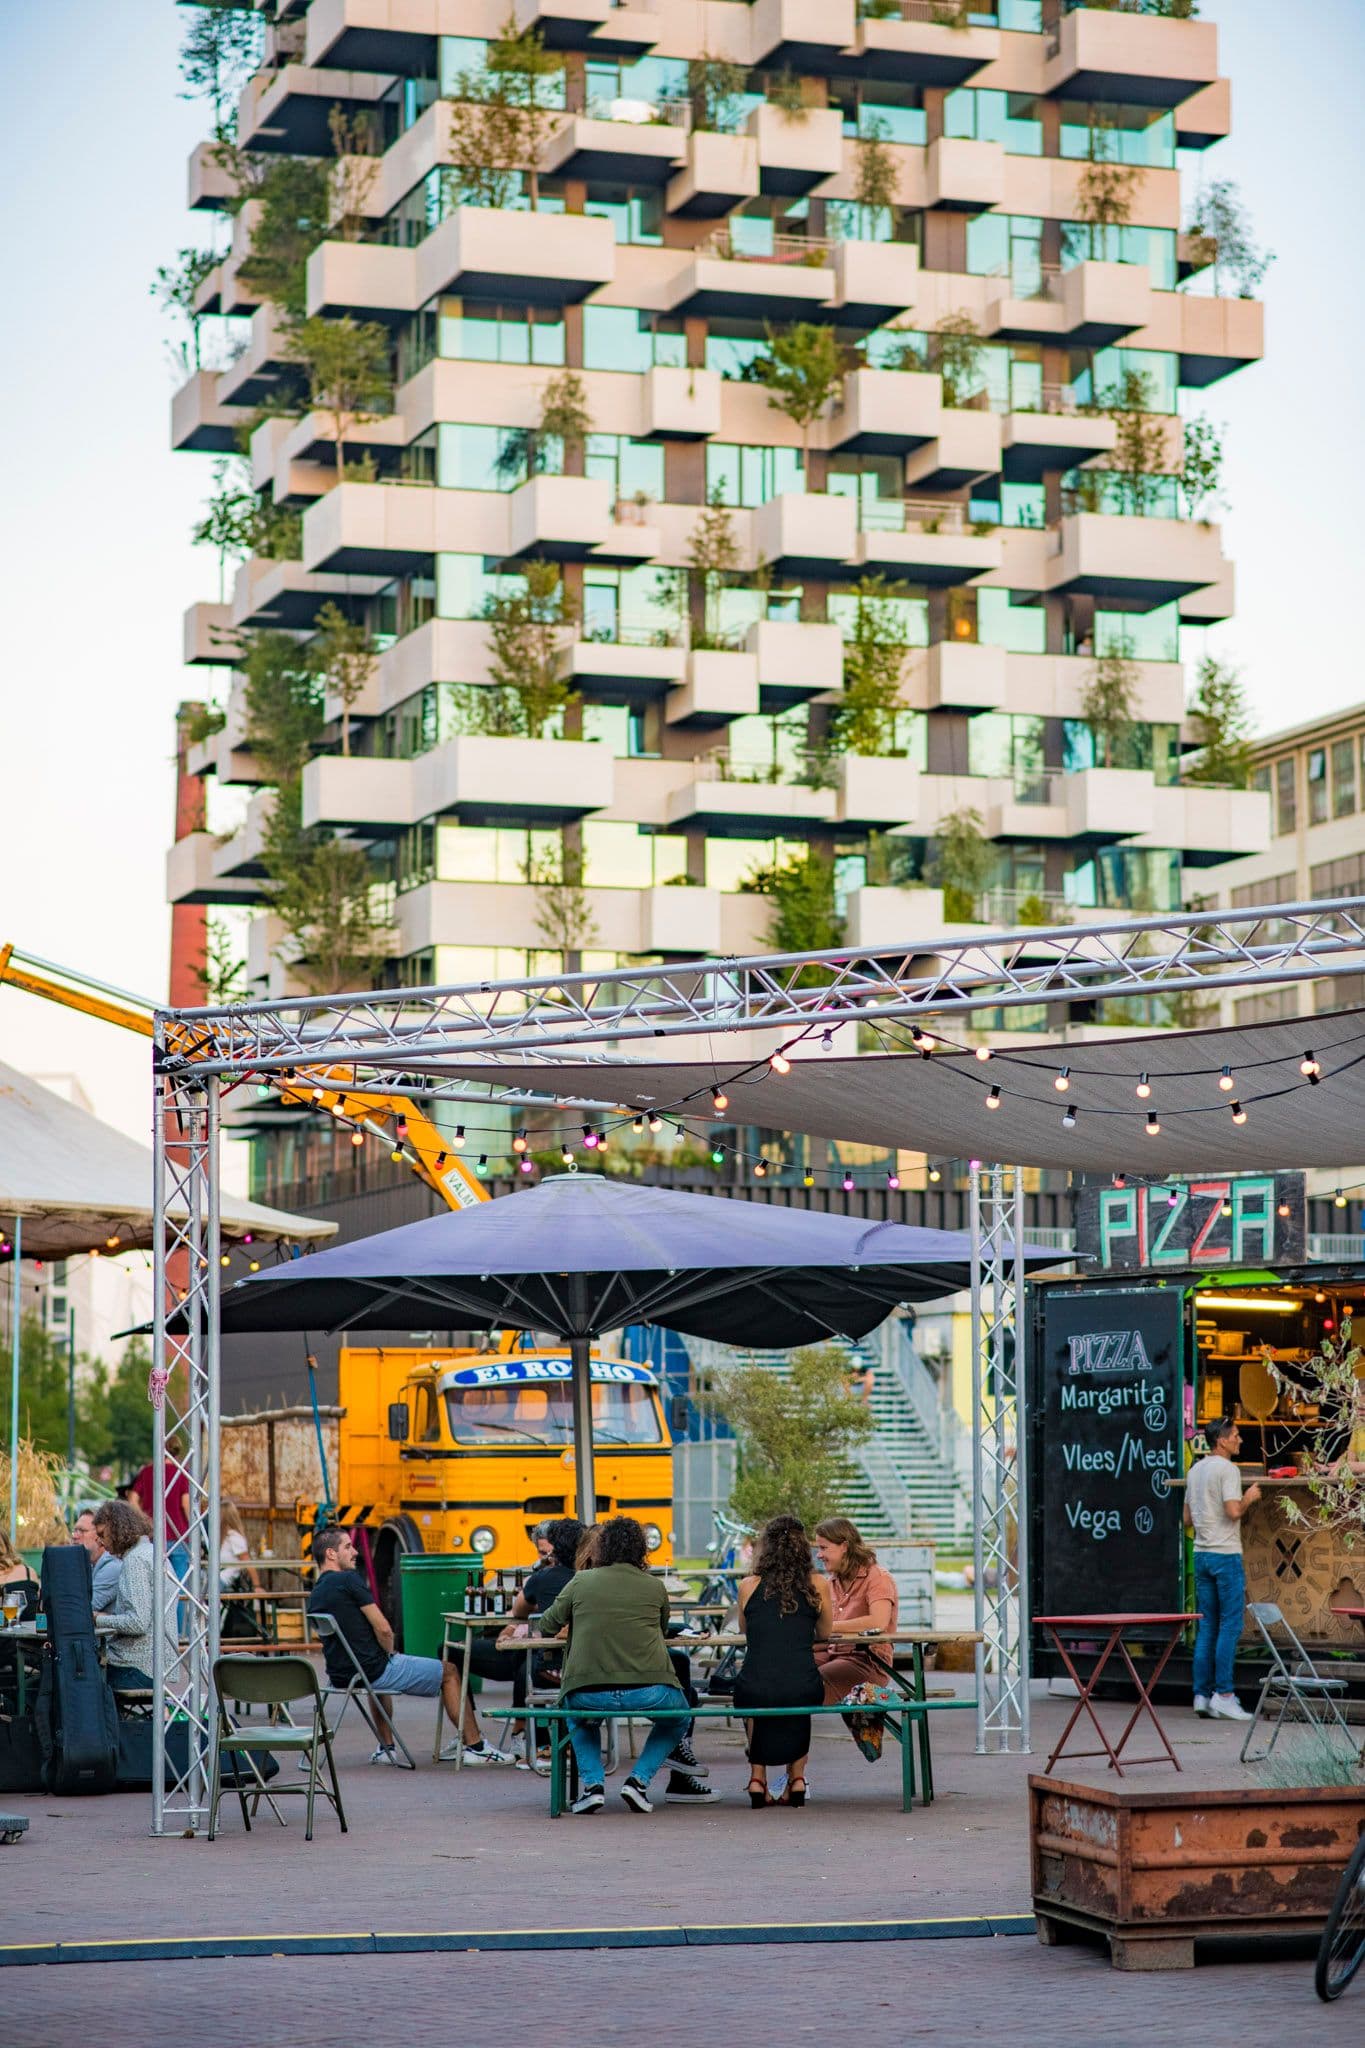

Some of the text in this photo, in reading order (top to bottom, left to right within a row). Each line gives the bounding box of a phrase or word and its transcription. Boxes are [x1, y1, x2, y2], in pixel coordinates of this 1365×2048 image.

[1099, 1177, 1275, 1269] PIZZA
[1067, 1329, 1153, 1375] PIZZA
[473, 1360, 636, 1383] EL ROHO
[1061, 1379, 1165, 1415] Margarita
[1146, 1407, 1164, 1428] 12
[1064, 1500, 1152, 1540] Vega 14
